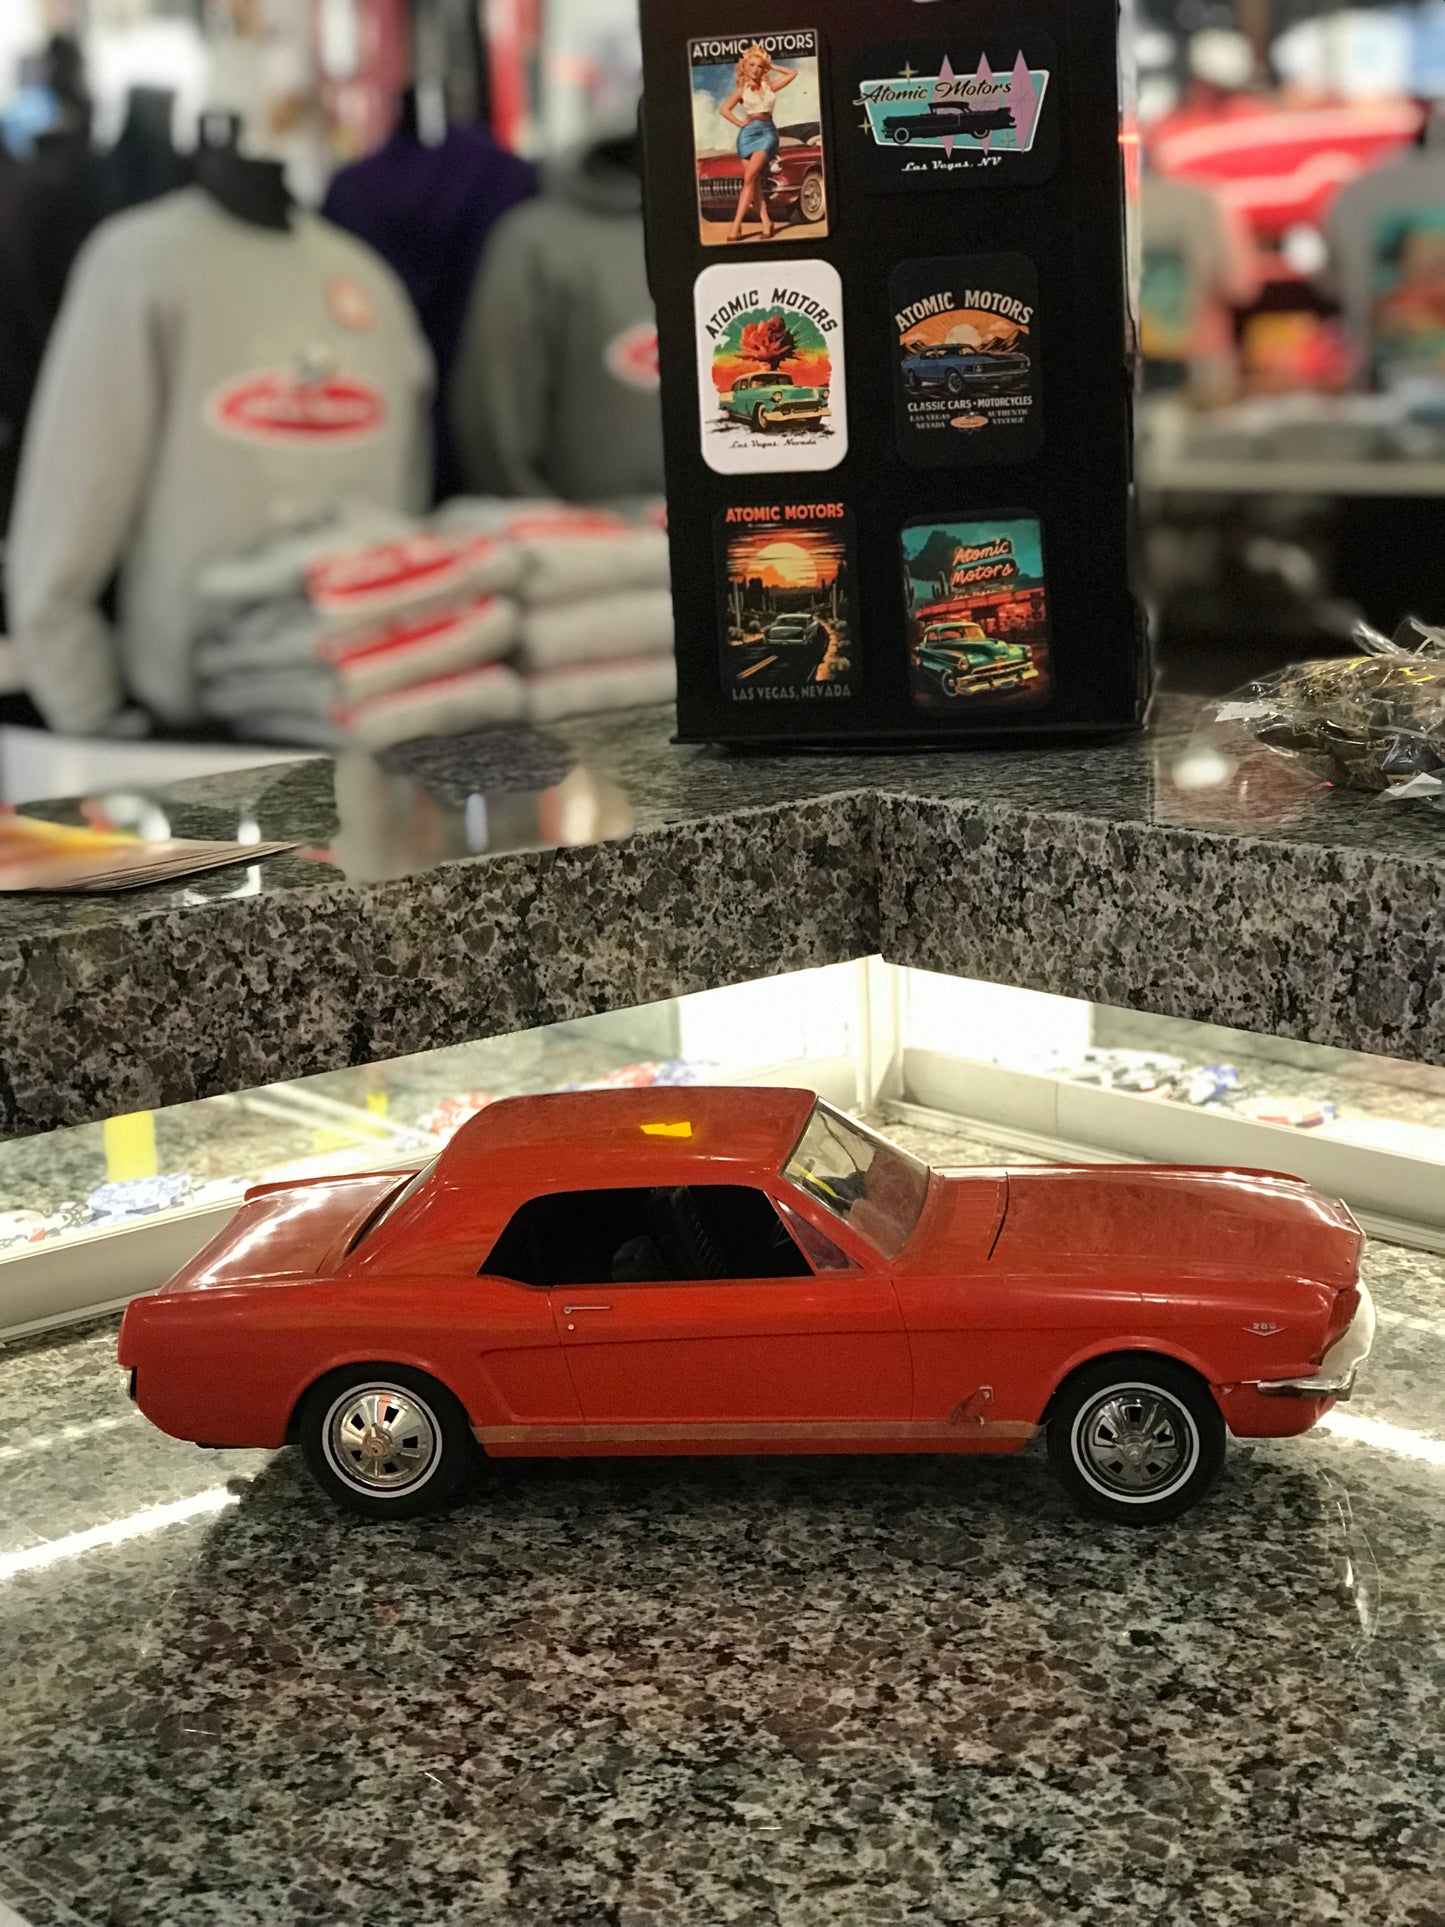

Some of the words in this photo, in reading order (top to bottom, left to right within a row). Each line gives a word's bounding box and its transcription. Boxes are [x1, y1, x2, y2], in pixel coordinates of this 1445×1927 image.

[693, 39, 749, 58] ATOMIC
[752, 33, 814, 52] MOTORS
[853, 84, 928, 105] Atomic
[934, 79, 1012, 98] Motors
[901, 162, 928, 172] Las
[977, 156, 1002, 167] NV
[705, 290, 759, 339] ATOMIC
[771, 288, 838, 332] MOTORS
[894, 291, 955, 333] ATOMIC
[964, 290, 1034, 324] MOTORS
[907, 401, 946, 412] CLASSIC
[947, 399, 972, 410] CARS
[977, 395, 1033, 408] MOTORCYCLES
[783, 438, 817, 446] Nevada
[725, 506, 781, 523] ATOMIC
[784, 502, 844, 520] MOTORS
[952, 539, 1009, 566] Atomic
[951, 562, 1014, 586] Motors
[732, 687, 755, 700] LAS
[756, 685, 800, 700] VEGAS,
[800, 683, 851, 698] NEVADA
